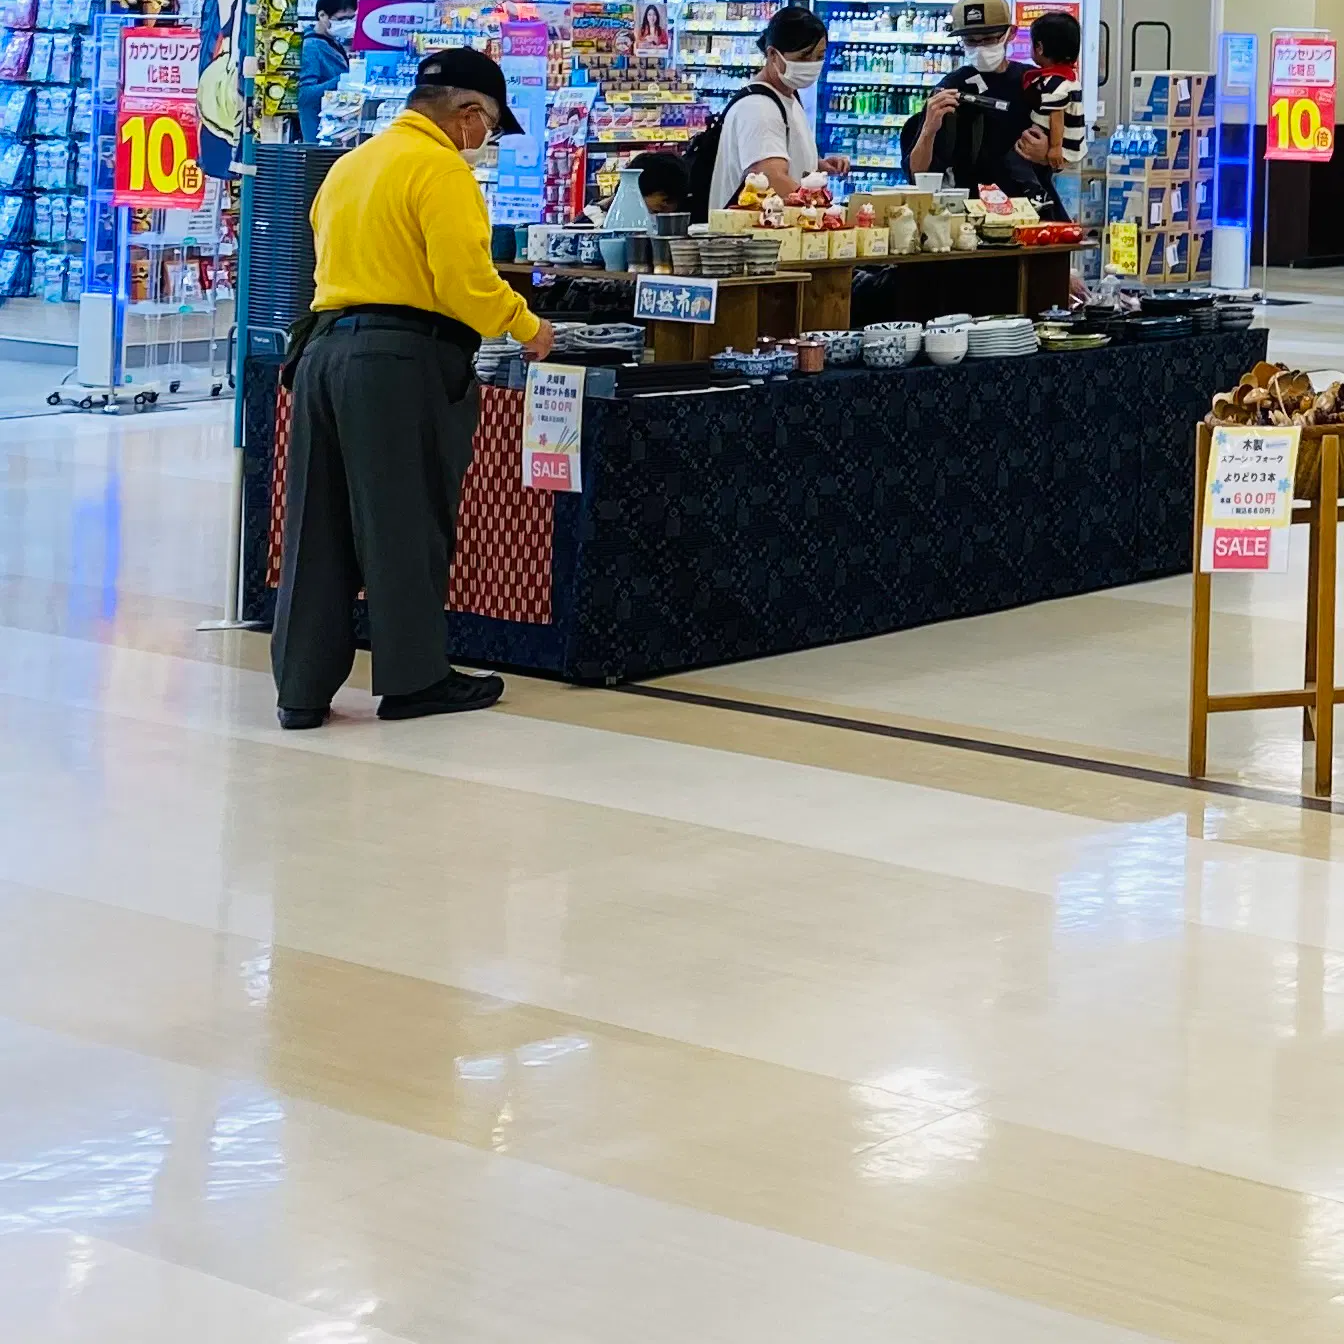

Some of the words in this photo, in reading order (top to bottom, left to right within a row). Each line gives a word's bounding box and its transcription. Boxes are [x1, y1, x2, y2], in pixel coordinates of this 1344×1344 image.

[128, 42, 201, 61] カウンセリング
[1277, 48, 1333, 61] カウンセリング
[147, 65, 181, 84] 化粧品
[1287, 63, 1316, 76] 化粧品
[640, 287, 691, 318] 陶器市
[1242, 438, 1264, 452] 木製
[532, 460, 569, 479] SALE
[1223, 472, 1277, 484] よりどり3本
[1233, 492, 1277, 506] 600円
[1215, 536, 1268, 557] SALE
